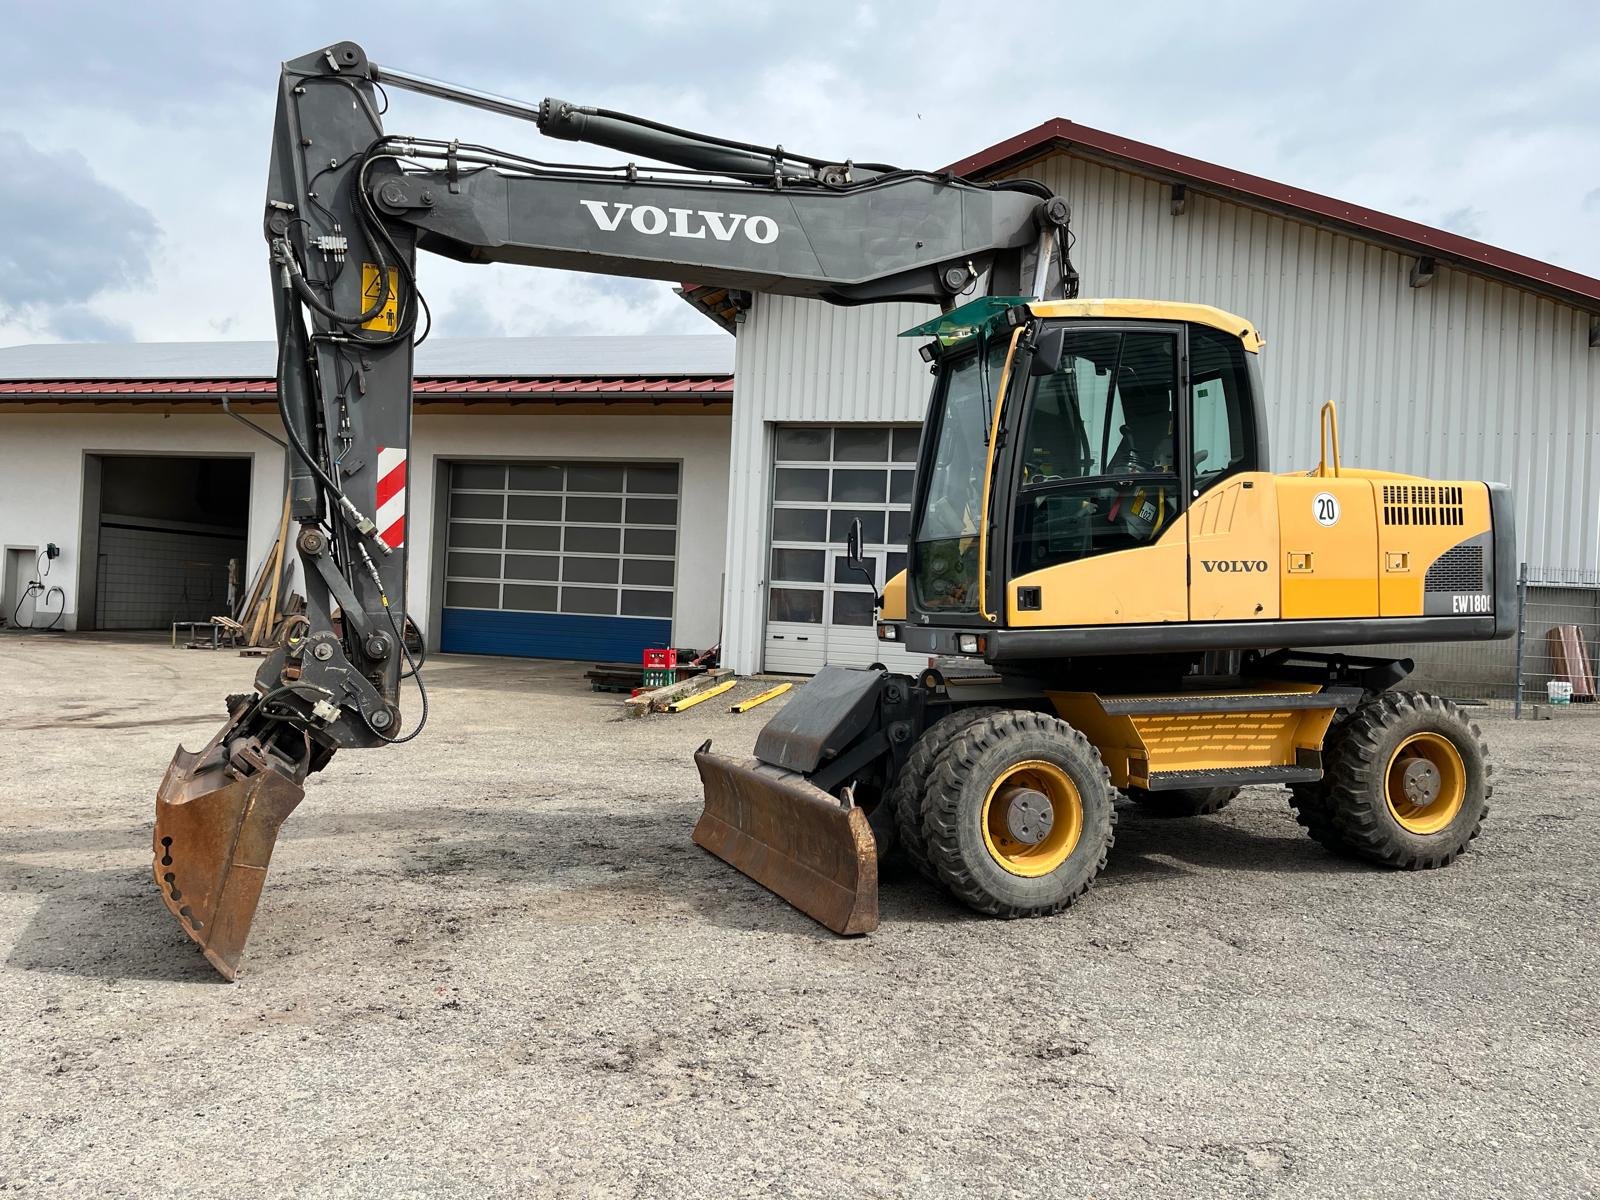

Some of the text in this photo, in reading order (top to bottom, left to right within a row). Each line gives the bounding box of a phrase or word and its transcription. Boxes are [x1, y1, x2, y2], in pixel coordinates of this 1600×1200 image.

[580, 200, 779, 244] VOLVO
[1318, 499, 1335, 520] 20
[1200, 560, 1268, 572] VOLVO
